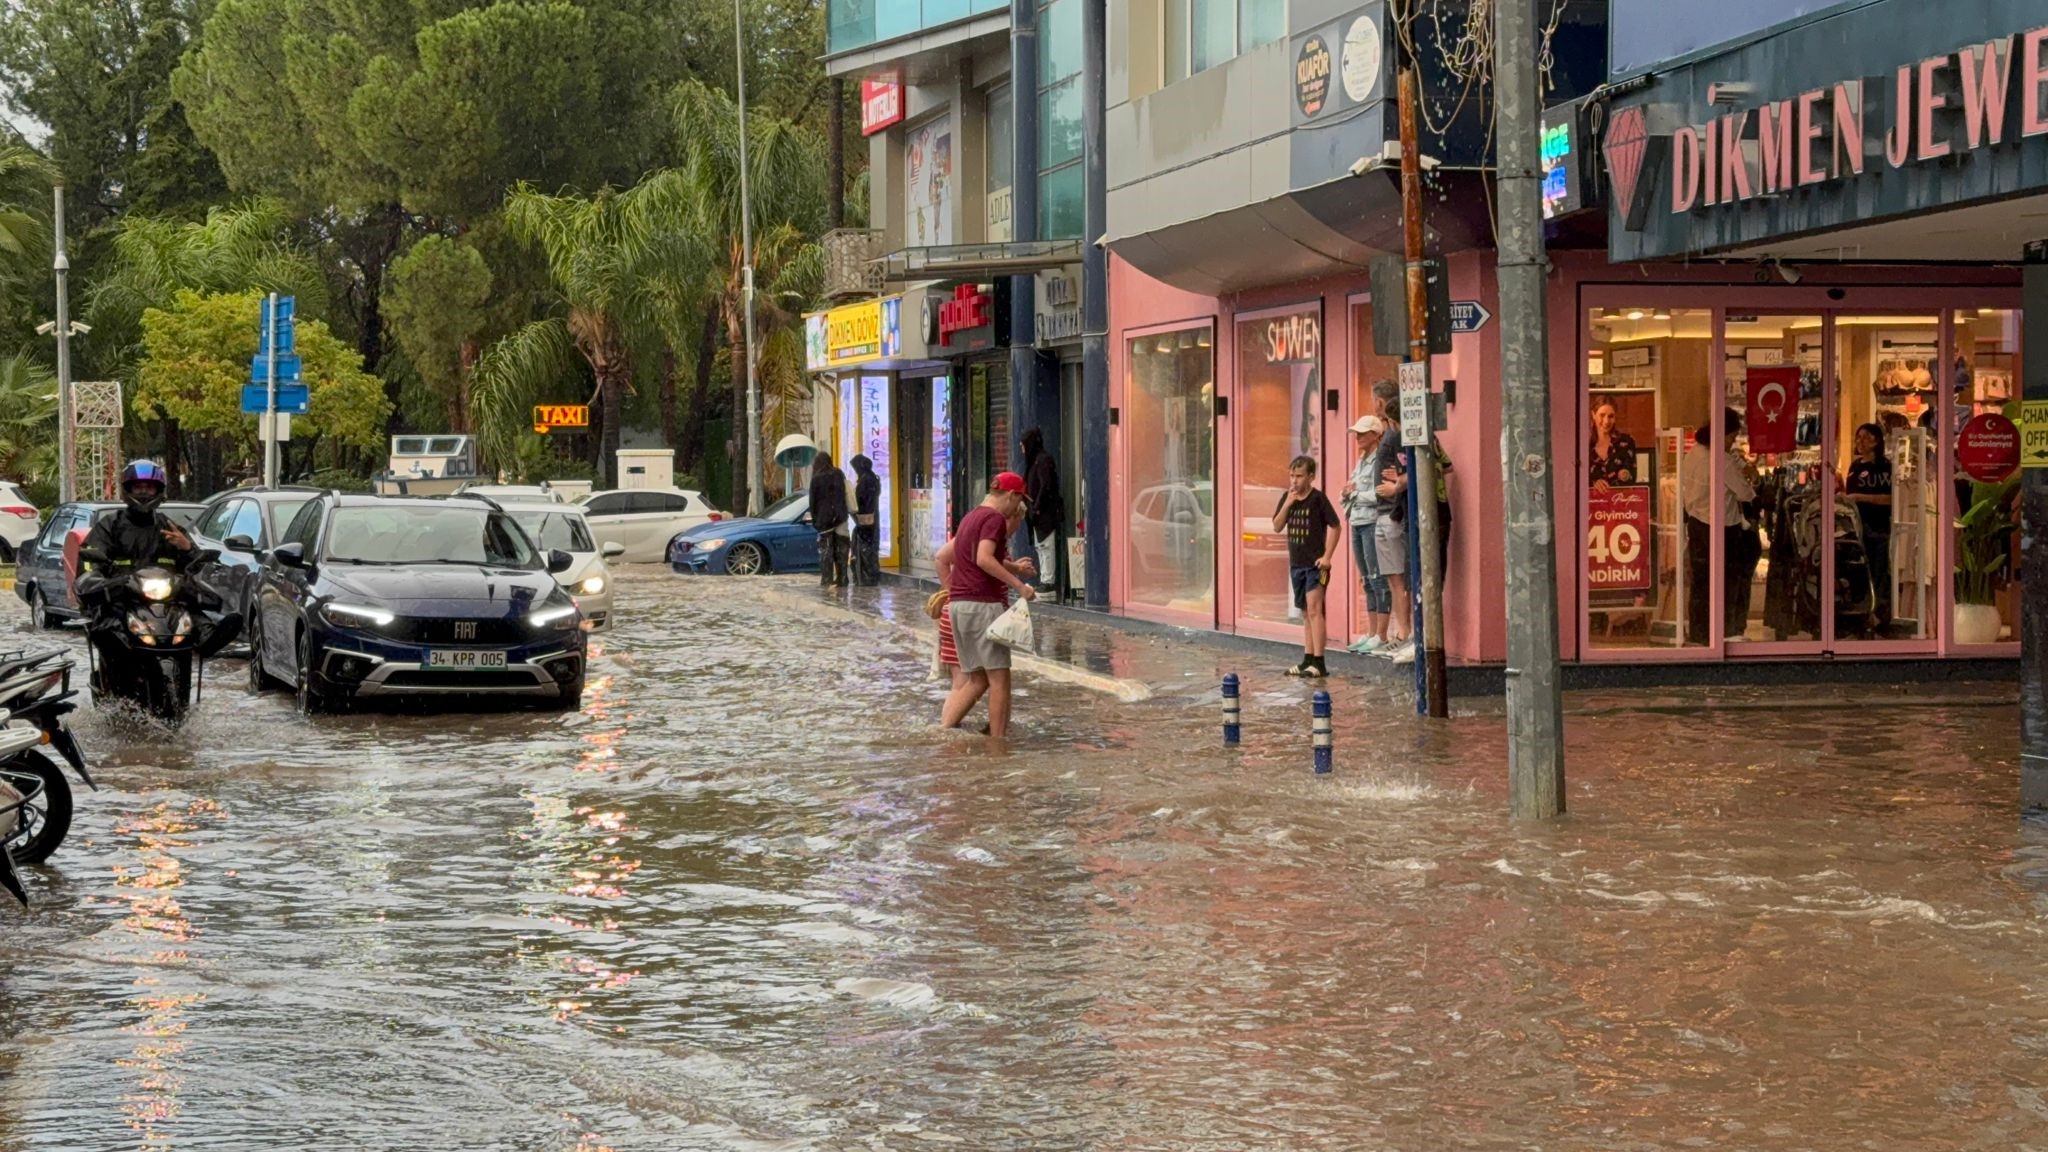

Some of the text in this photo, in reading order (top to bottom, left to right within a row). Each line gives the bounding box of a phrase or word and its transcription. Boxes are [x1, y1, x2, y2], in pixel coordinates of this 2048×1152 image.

[1886, 26, 2048, 169] JEWE
[938, 284, 985, 348] public
[1451, 320, 1468, 329] AK
[1266, 315, 1320, 362] SUWEN
[540, 406, 582, 425] TAXI
[871, 386, 880, 461] CHANGE
[1594, 510, 1639, 522] Giyimde
[1588, 524, 1641, 564] 40
[454, 621, 478, 639] FIAT
[431, 652, 503, 666] 34 KPR 005
